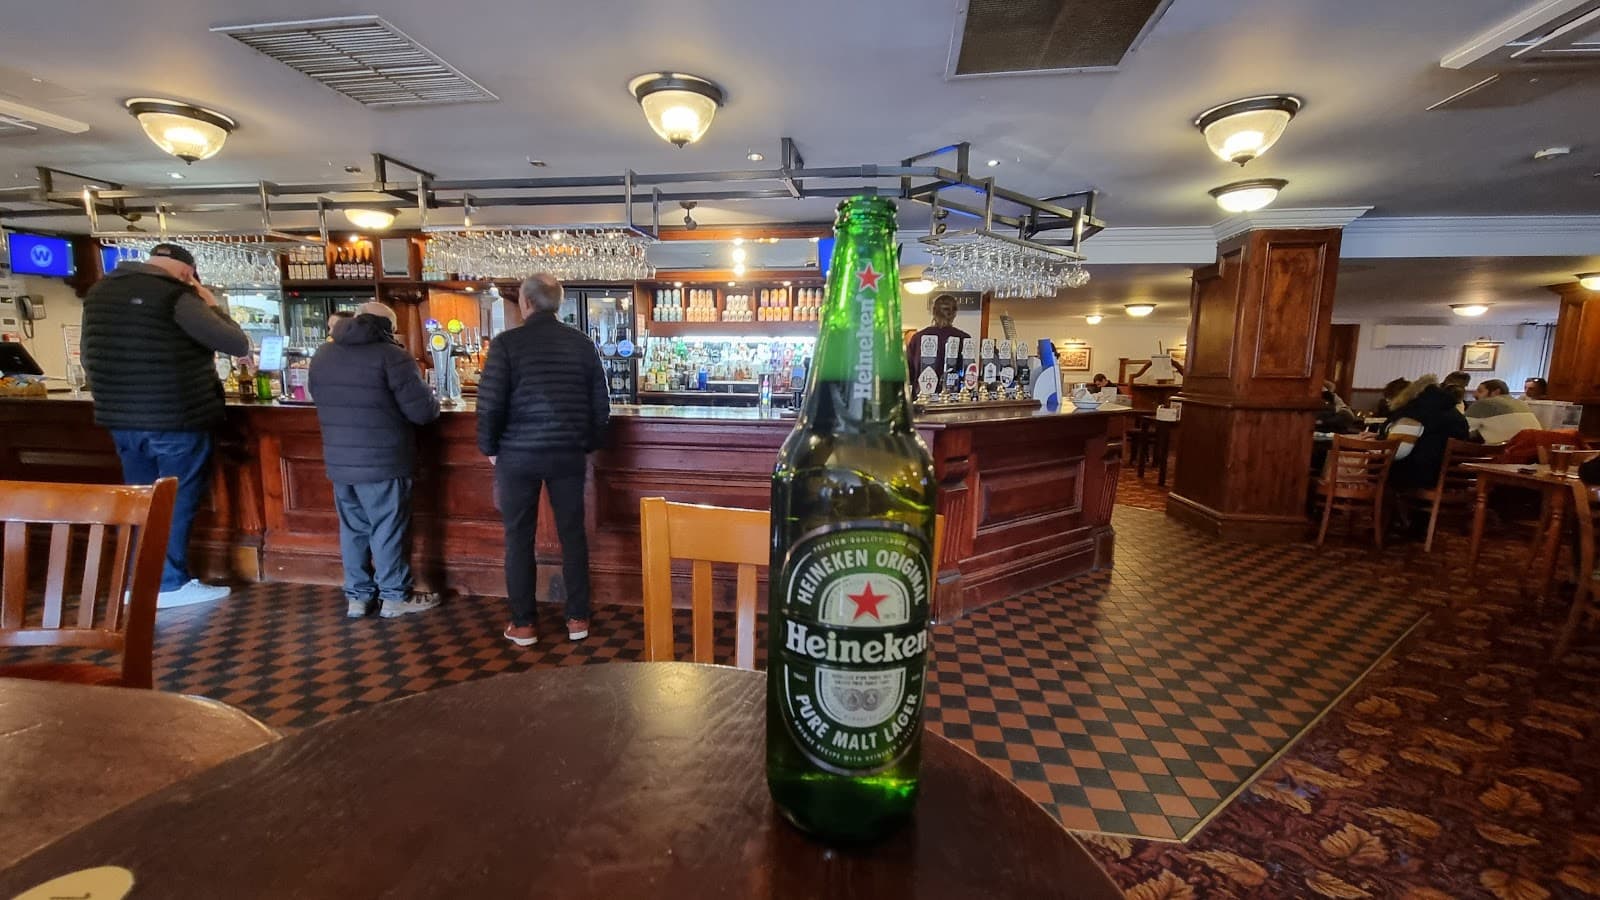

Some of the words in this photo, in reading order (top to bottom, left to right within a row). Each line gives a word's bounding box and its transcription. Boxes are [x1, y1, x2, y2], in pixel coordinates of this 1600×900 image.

[33, 248, 50, 263] W
[853, 297, 875, 400] Heineken
[797, 549, 869, 605] HEINEKEN
[876, 549, 926, 606] ORIGINAL
[786, 620, 928, 666] Heineken
[795, 694, 830, 739] PURE
[832, 730, 877, 751] MALT
[884, 693, 918, 742] LAGER
